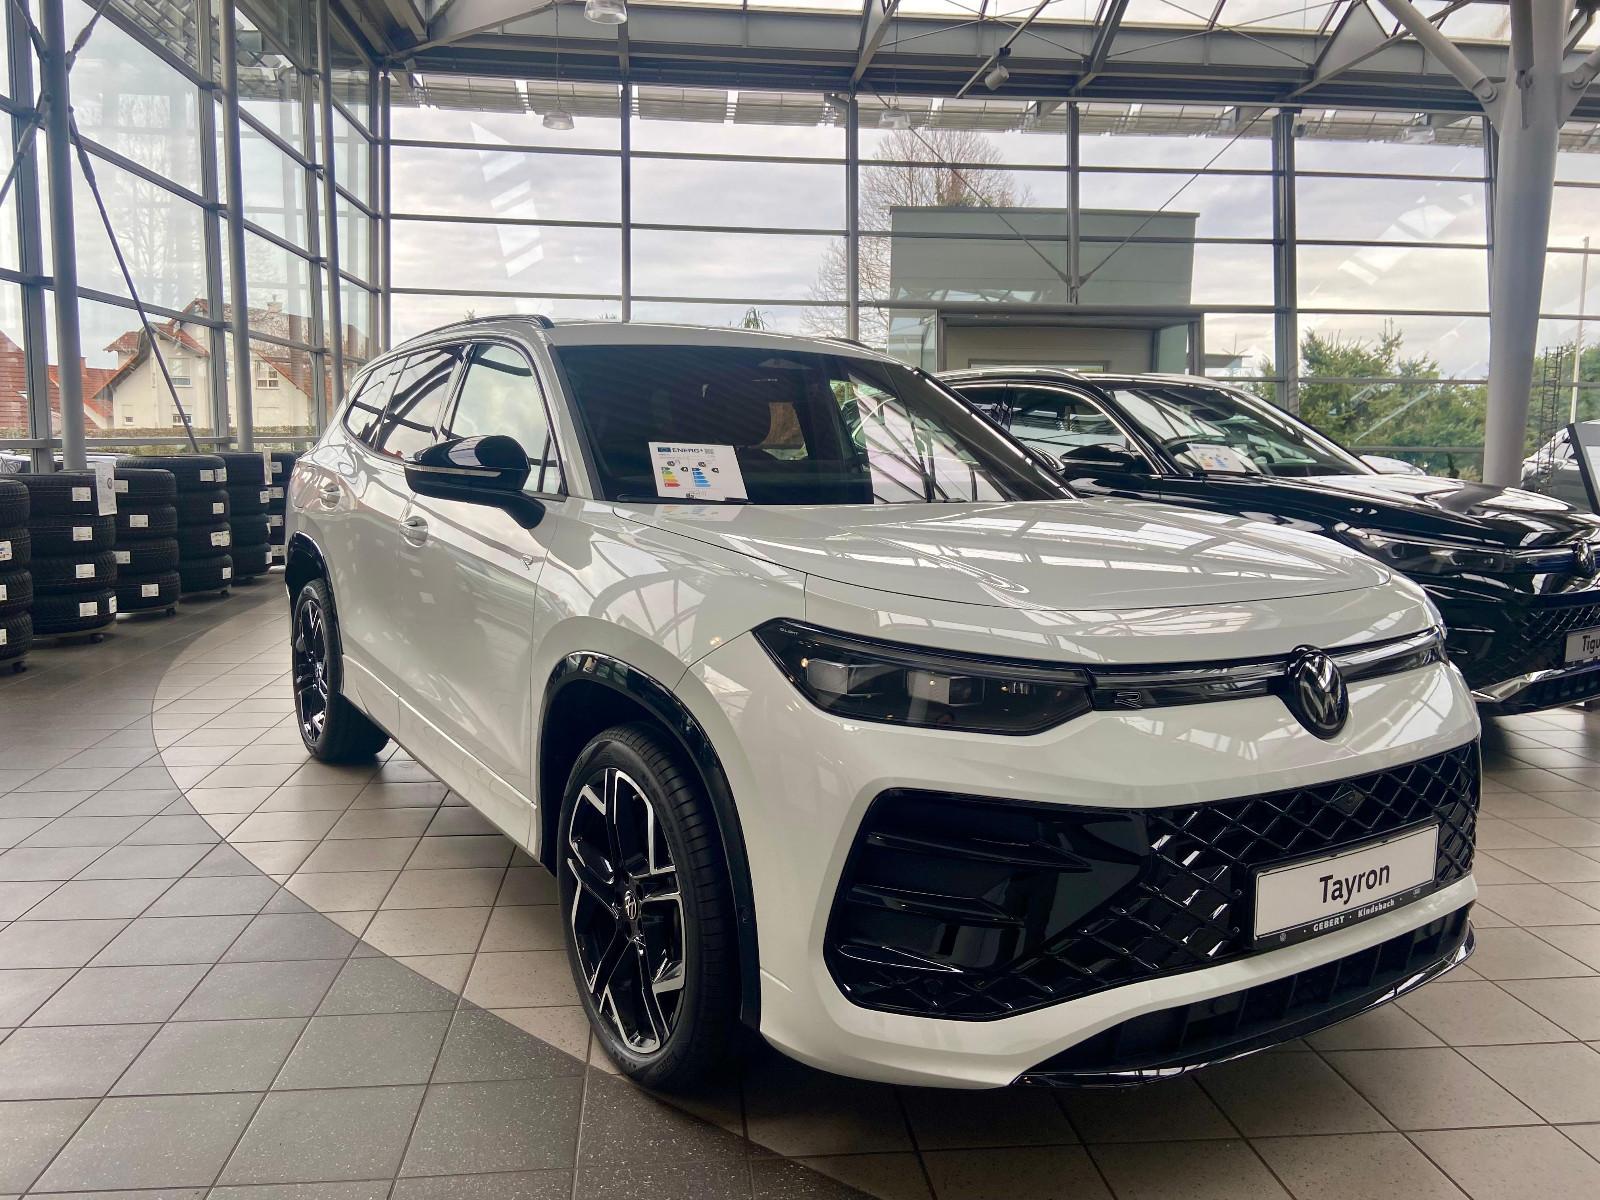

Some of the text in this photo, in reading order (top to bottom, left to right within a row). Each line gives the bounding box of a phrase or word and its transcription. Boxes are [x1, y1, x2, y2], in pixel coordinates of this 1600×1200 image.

[1319, 864, 1390, 905] Tayron
[1313, 899, 1395, 932] GEBERT Kindsbach
